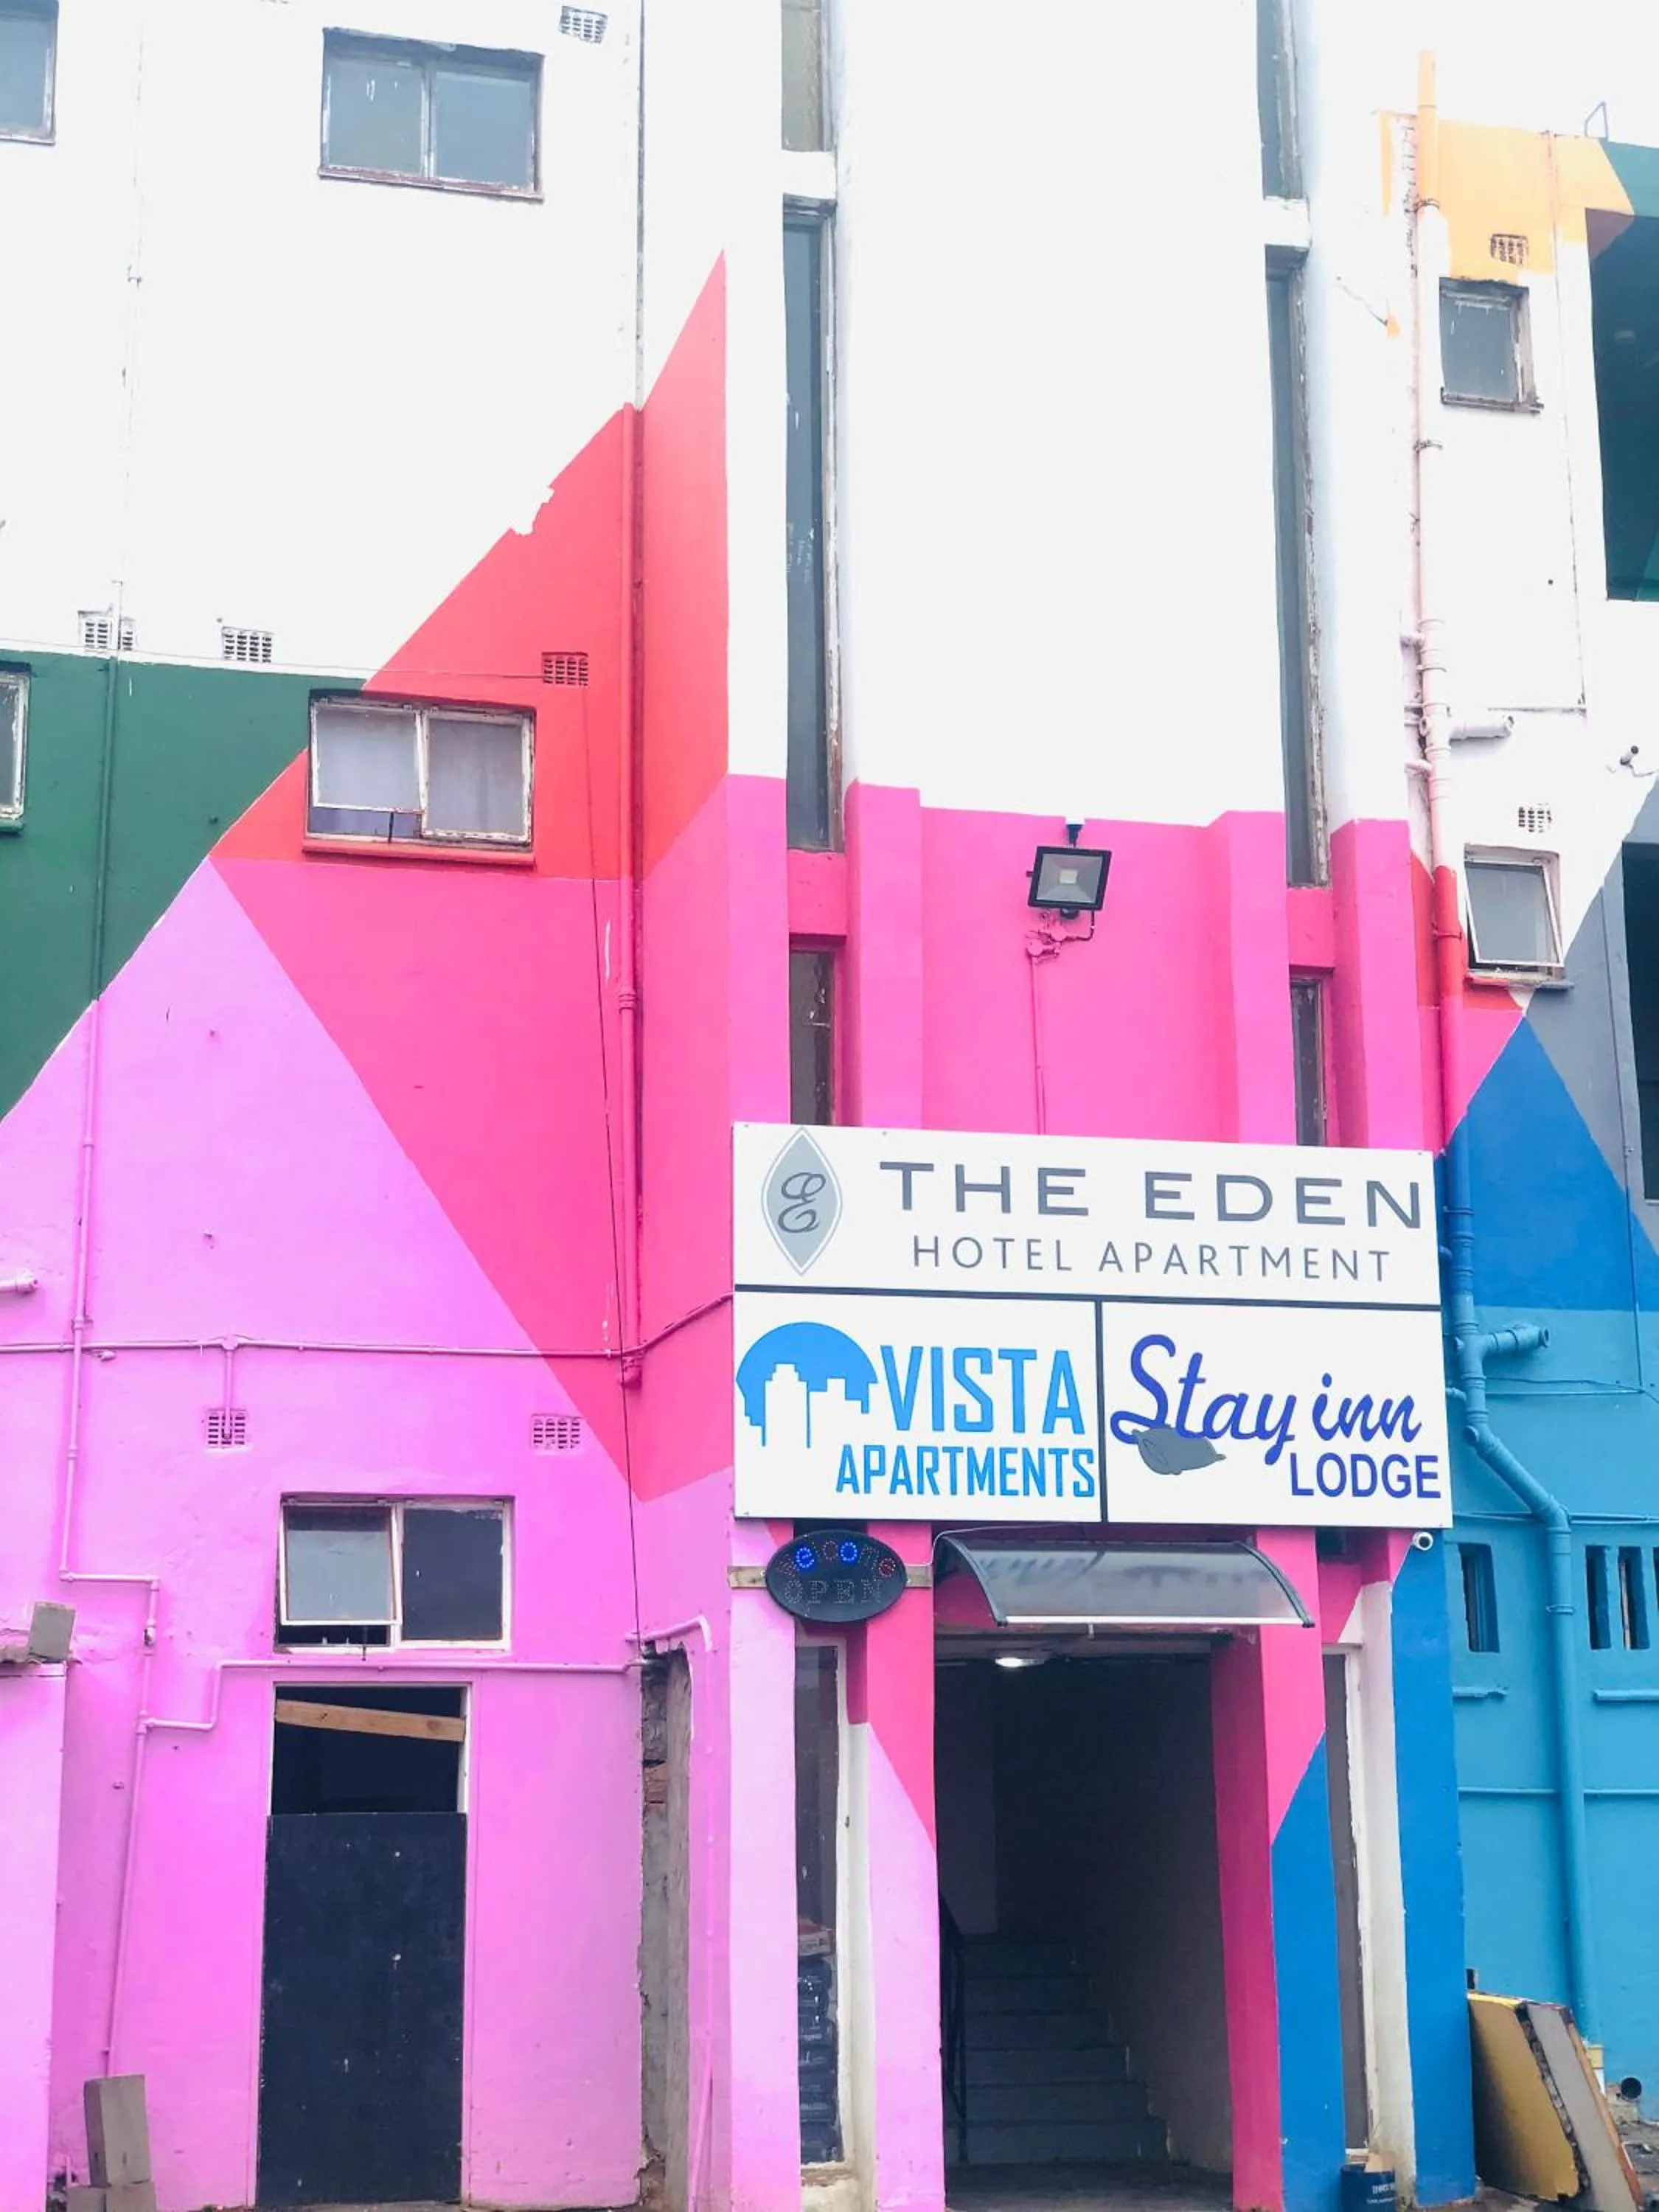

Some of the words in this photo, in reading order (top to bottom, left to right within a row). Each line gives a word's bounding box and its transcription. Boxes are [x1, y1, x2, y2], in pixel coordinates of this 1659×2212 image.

[880, 1161, 1089, 1217] THE
[1144, 1172, 1421, 1229] EDEN
[914, 1235, 1072, 1271] HOTEL
[1098, 1241, 1390, 1282] APARTMENT
[880, 1344, 1086, 1436] VISTA
[1110, 1334, 1298, 1465] Stay
[1312, 1372, 1422, 1444] inn
[835, 1443, 1096, 1499] APARTMENTS
[1290, 1452, 1441, 1499] LODGE
[784, 1578, 883, 1605] OPEN
